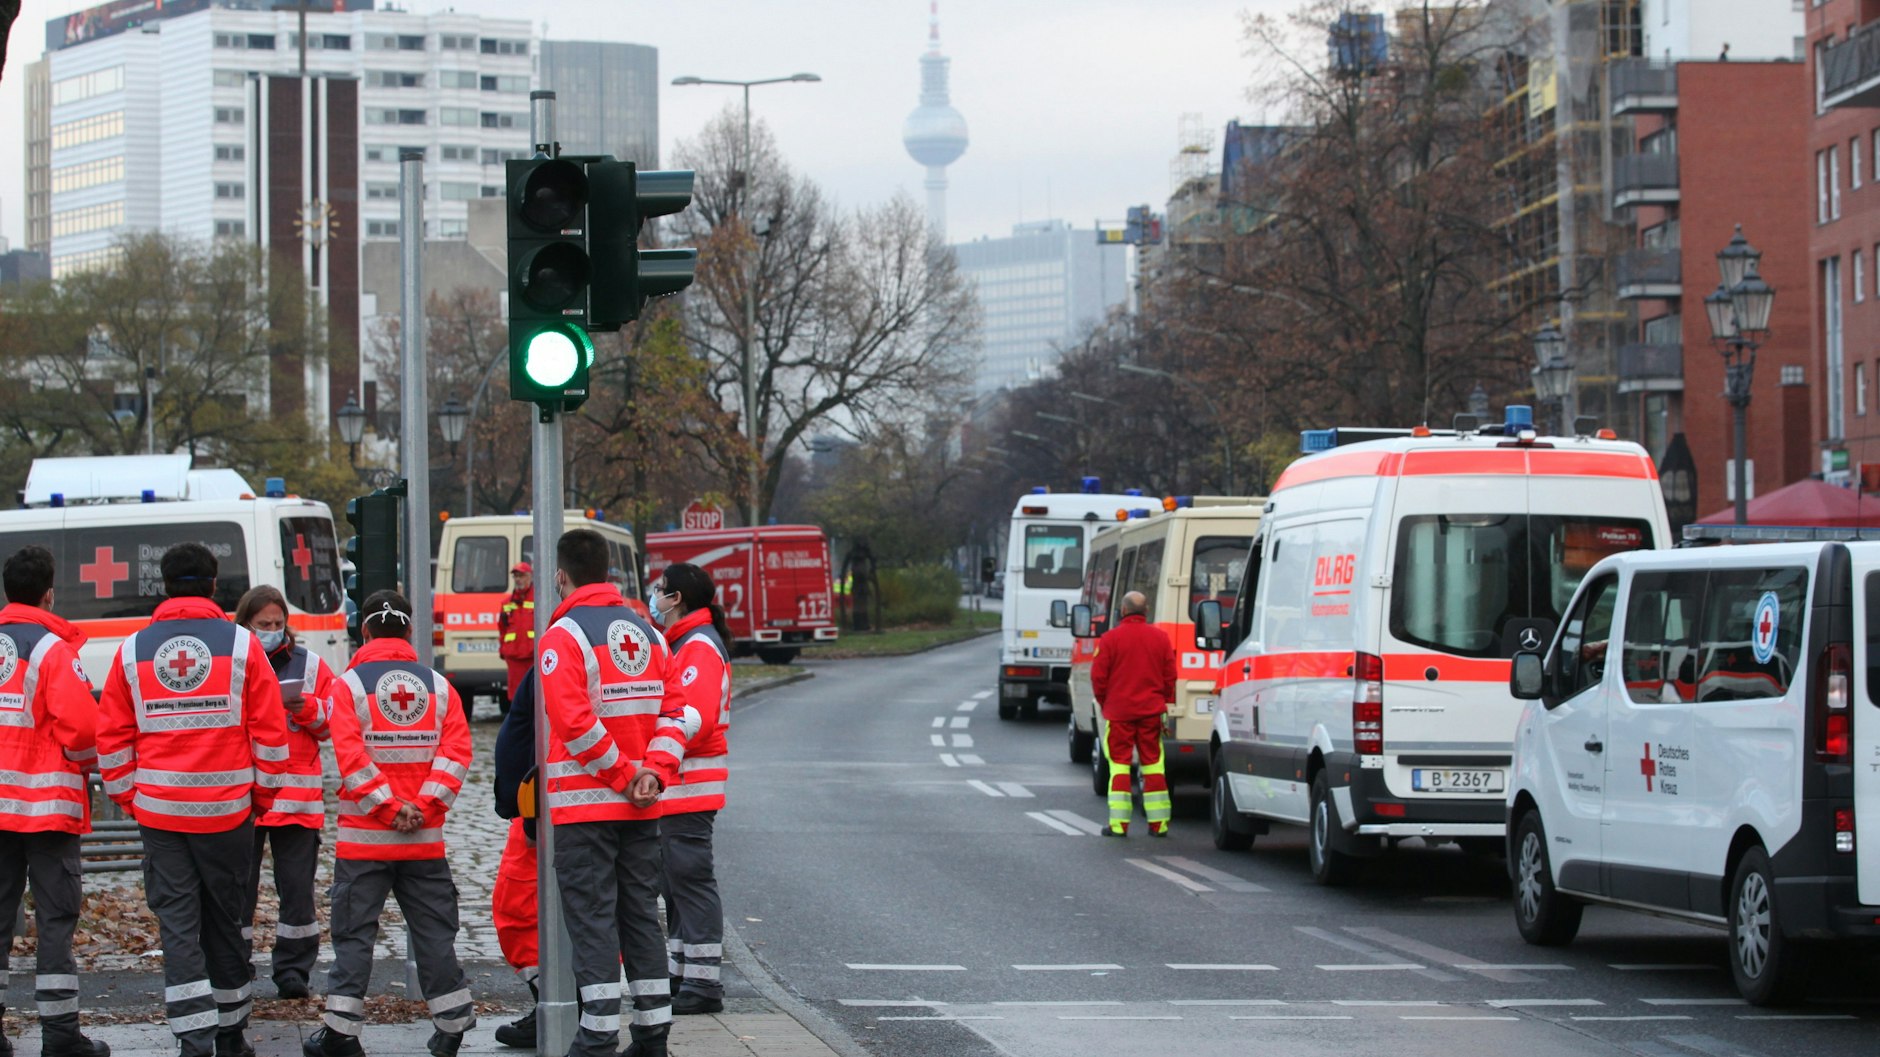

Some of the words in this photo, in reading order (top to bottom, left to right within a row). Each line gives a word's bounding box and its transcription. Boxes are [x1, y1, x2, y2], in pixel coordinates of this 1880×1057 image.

[686, 511, 720, 529] STOP
[1314, 553, 1356, 586] DLRG
[714, 583, 745, 619] 12
[798, 600, 828, 620] 112
[447, 612, 500, 625] DLR
[611, 623, 644, 643] DEUTSCHES
[160, 639, 206, 659] DEUTSCHES
[612, 648, 632, 672] ROTES
[634, 648, 648, 672] KREUZ
[1181, 652, 1221, 669] DL
[158, 666, 181, 689] ROTES
[184, 663, 207, 688] KREUZ
[380, 673, 423, 692] DEUTSCHES
[146, 703, 154, 711] KV
[154, 702, 175, 711] Wedding
[178, 701, 204, 709] Prenzlauer
[205, 699, 217, 708] Berg
[381, 699, 403, 722] ROTES
[405, 697, 426, 721] KREUZ
[365, 734, 373, 742] KV
[373, 734, 394, 742] Wedding
[420, 733, 430, 742] Berg
[1658, 743, 1689, 761] Deutsches
[1659, 761, 1676, 777] Rotes
[1432, 772, 1442, 786] B
[1452, 772, 1491, 787] 2367
[1660, 779, 1678, 795] Kreuz
